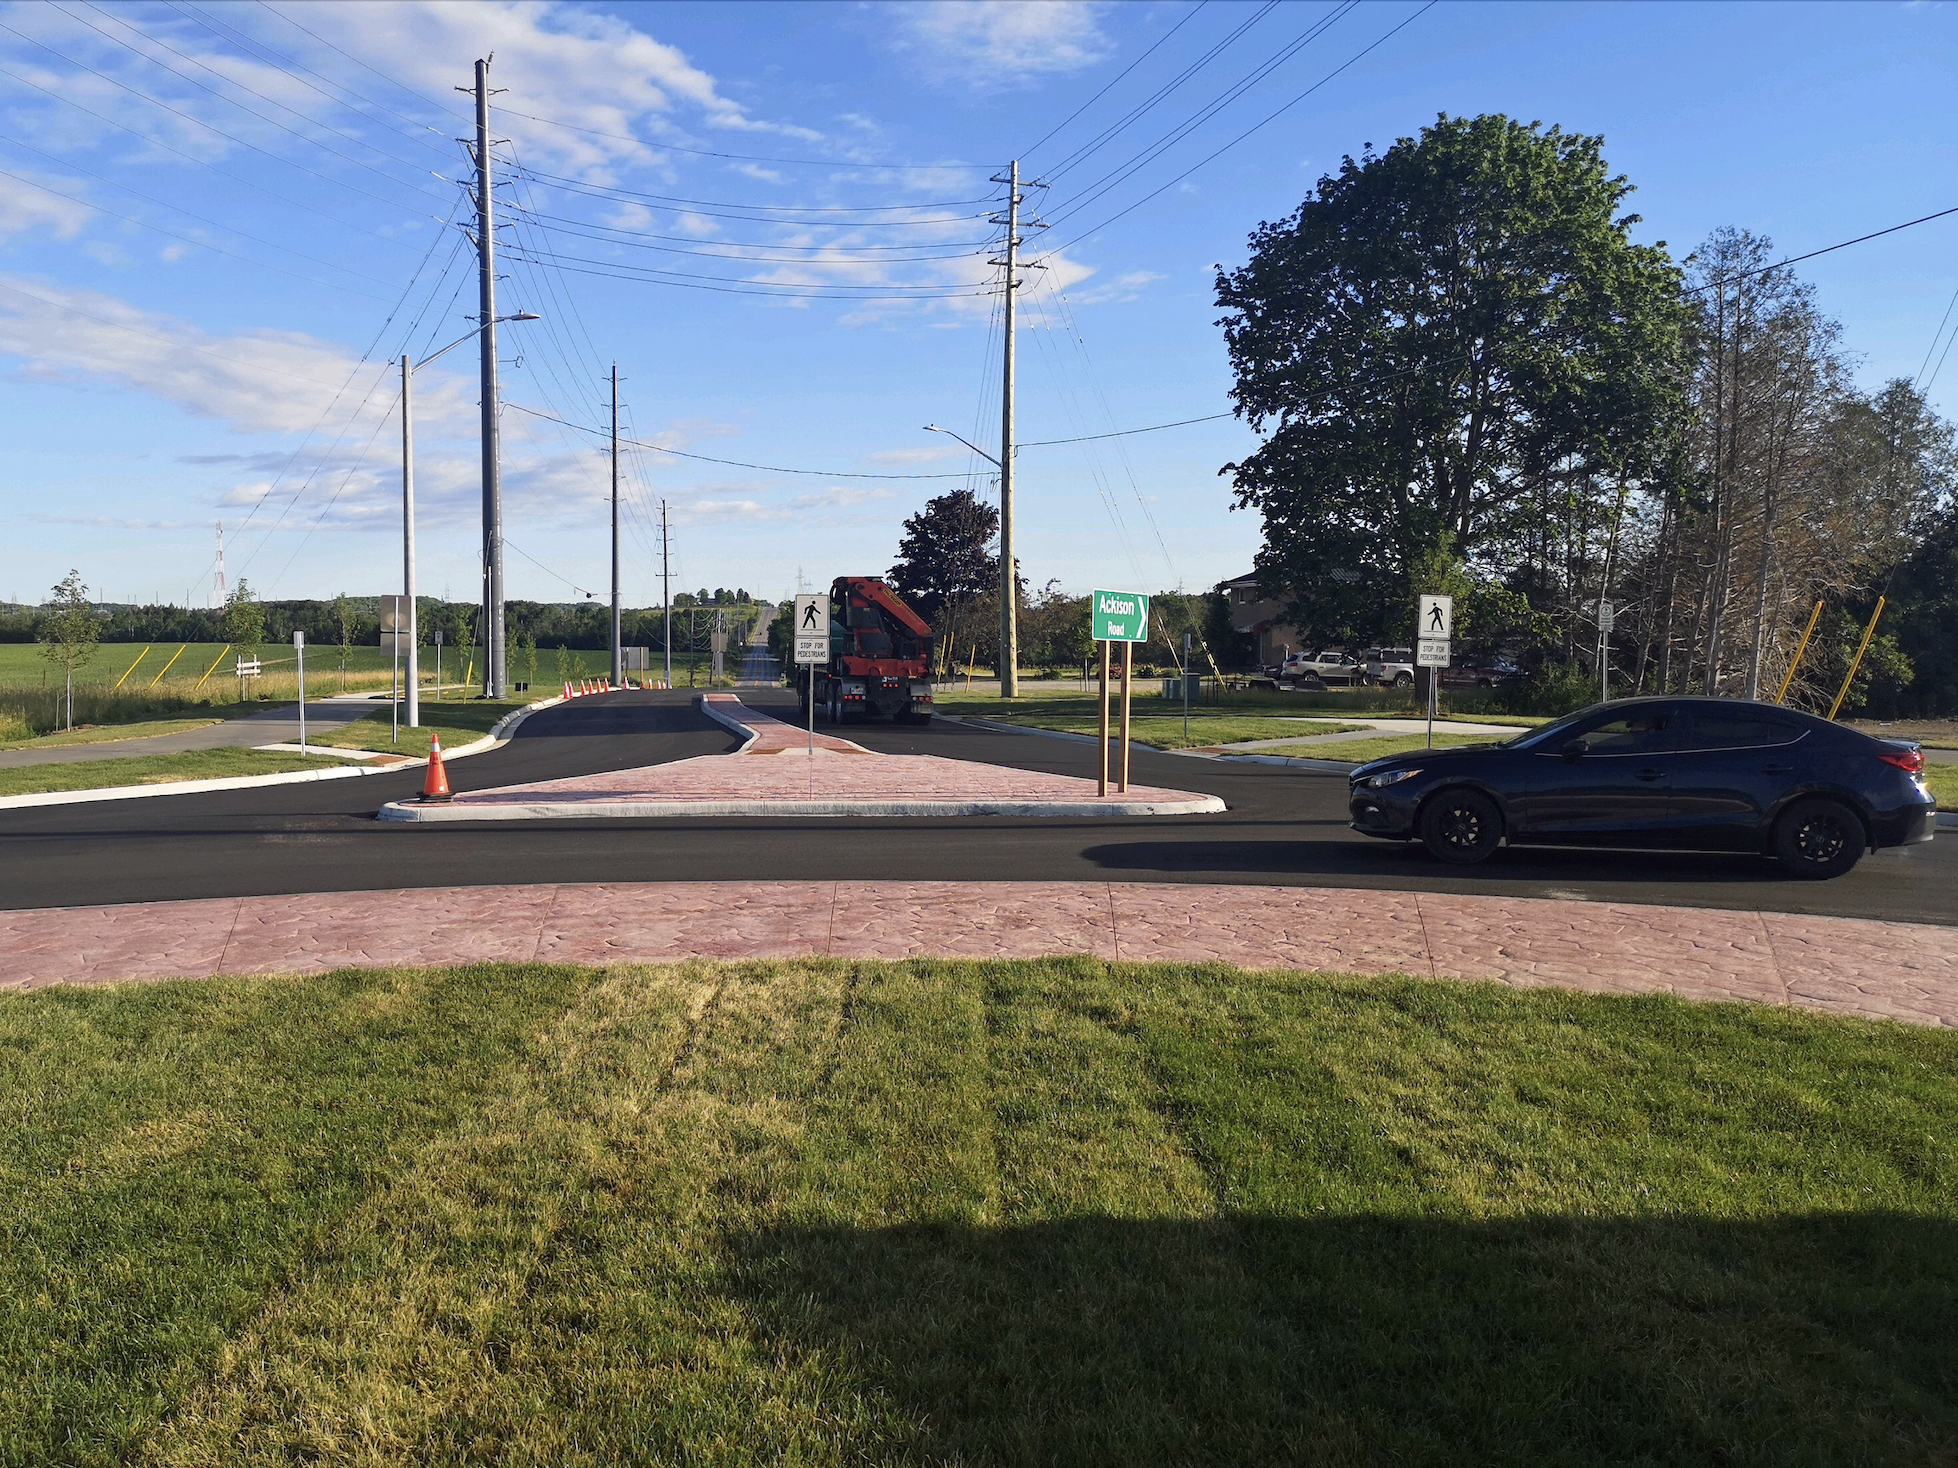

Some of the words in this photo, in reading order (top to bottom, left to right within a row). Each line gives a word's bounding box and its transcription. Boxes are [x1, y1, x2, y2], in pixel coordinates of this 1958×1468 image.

[1099, 594, 1134, 616] Ackison
[1107, 620, 1125, 636] Road
[1420, 653, 1447, 661] PEDESTRIANS
